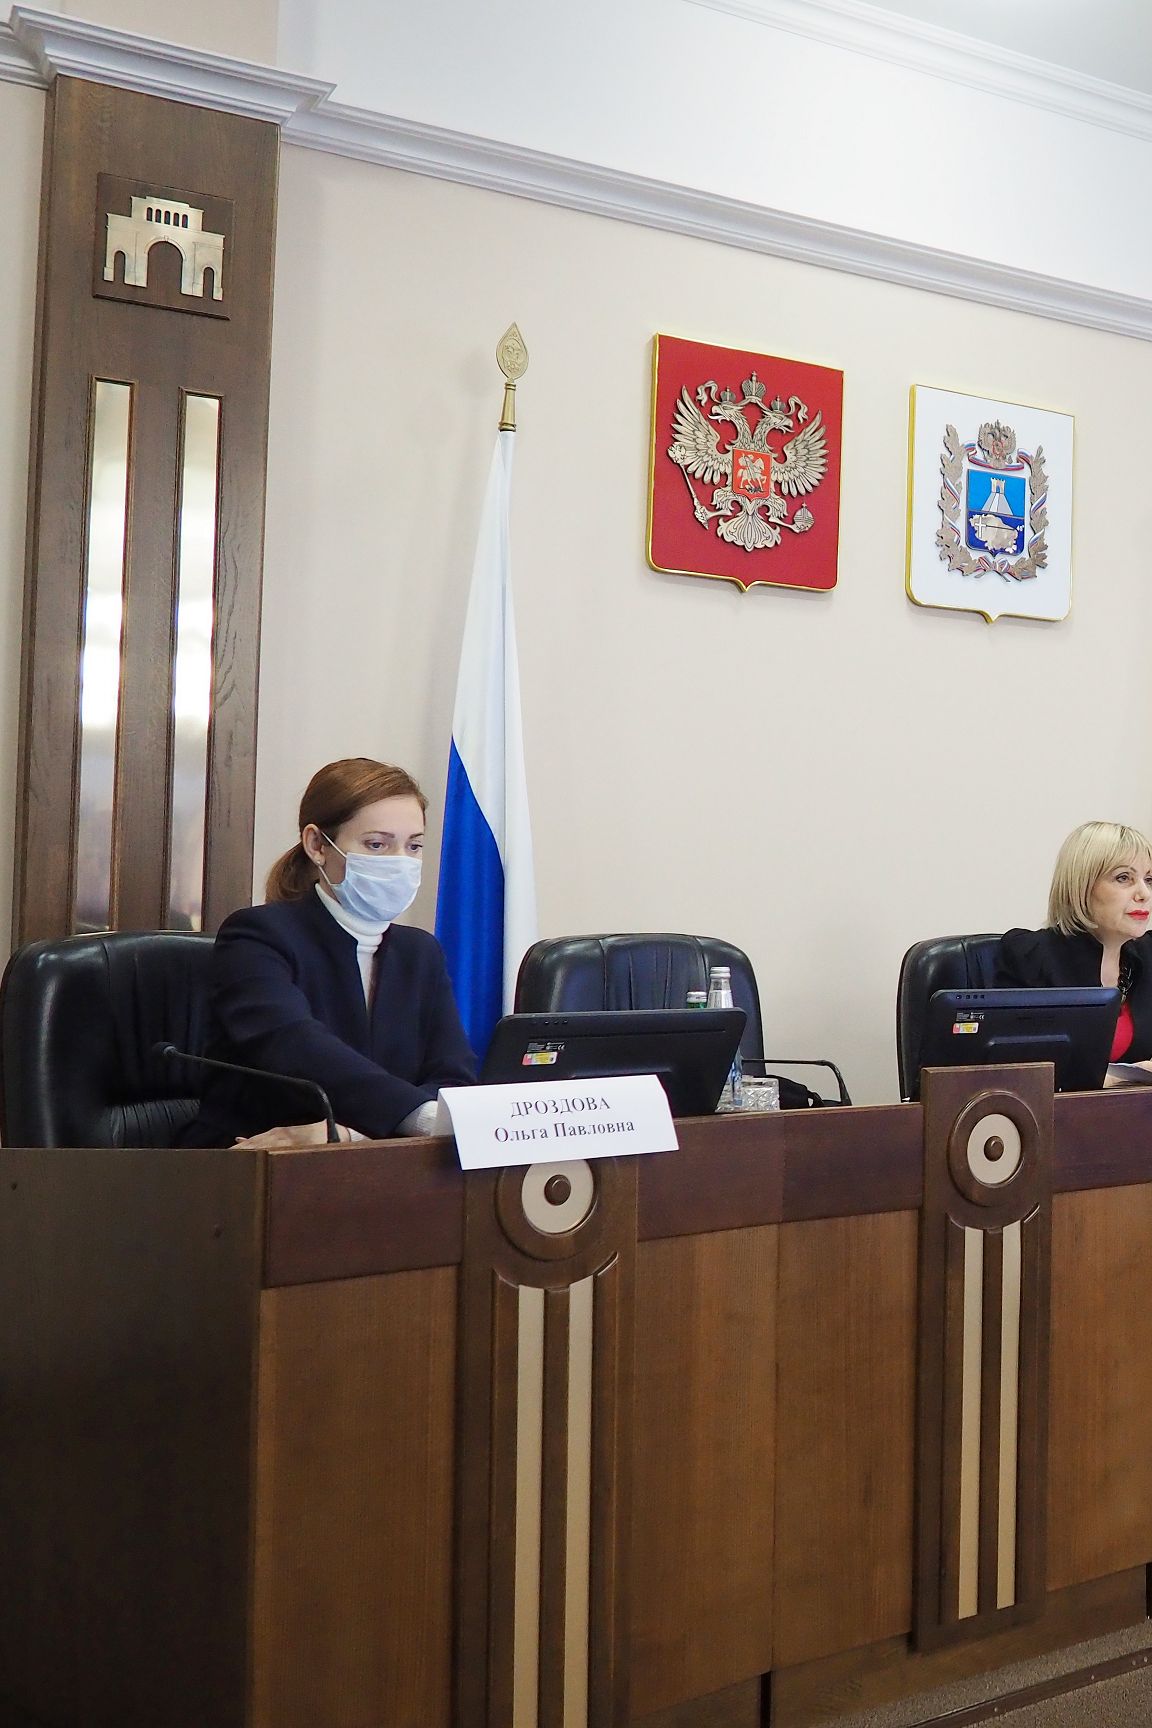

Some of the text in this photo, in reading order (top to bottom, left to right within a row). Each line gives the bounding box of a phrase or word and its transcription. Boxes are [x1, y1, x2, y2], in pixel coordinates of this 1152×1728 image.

[510, 1097, 611, 1118] ДРОЗДОВА
[494, 1120, 635, 1143] Ольга Павловна
